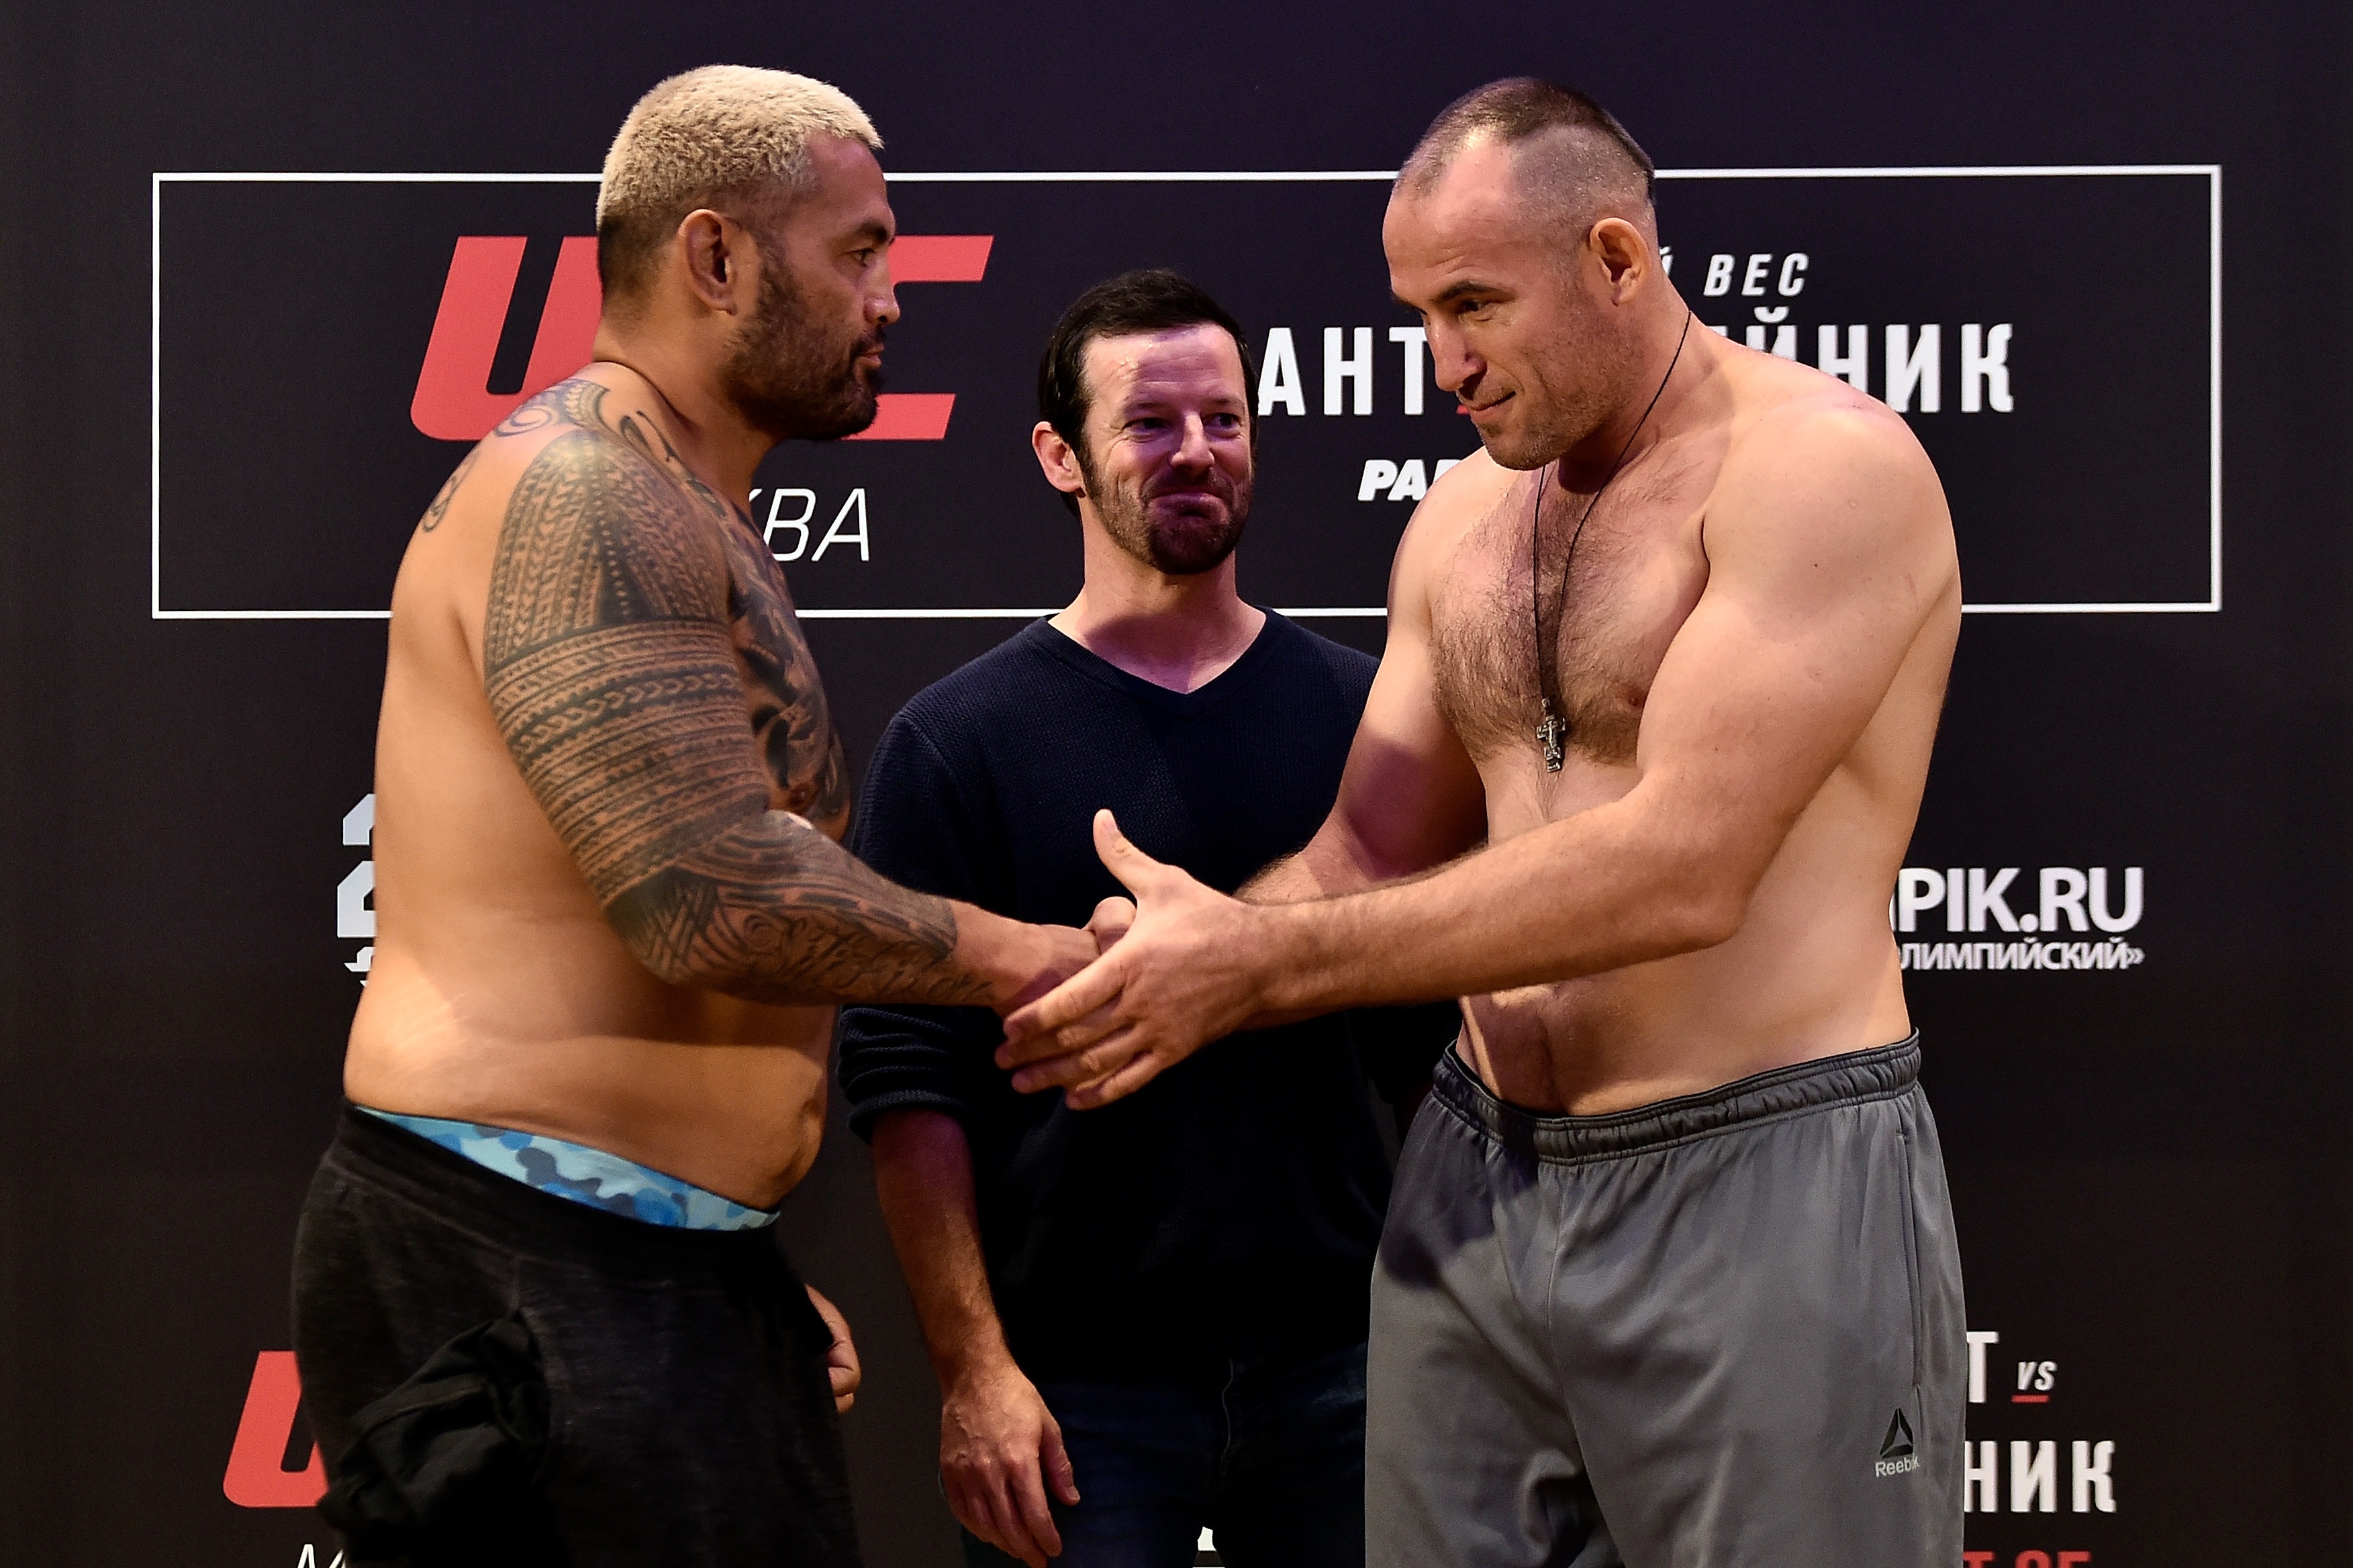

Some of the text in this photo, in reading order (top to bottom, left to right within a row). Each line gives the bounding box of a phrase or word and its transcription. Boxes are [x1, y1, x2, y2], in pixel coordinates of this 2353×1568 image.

[1703, 252, 1810, 297] ВЕС
[749, 487, 869, 562] ВА
[1888, 867, 2144, 933] PIK.RU
[1897, 936, 2145, 971] ЛИМПИЙСКИЙ»
